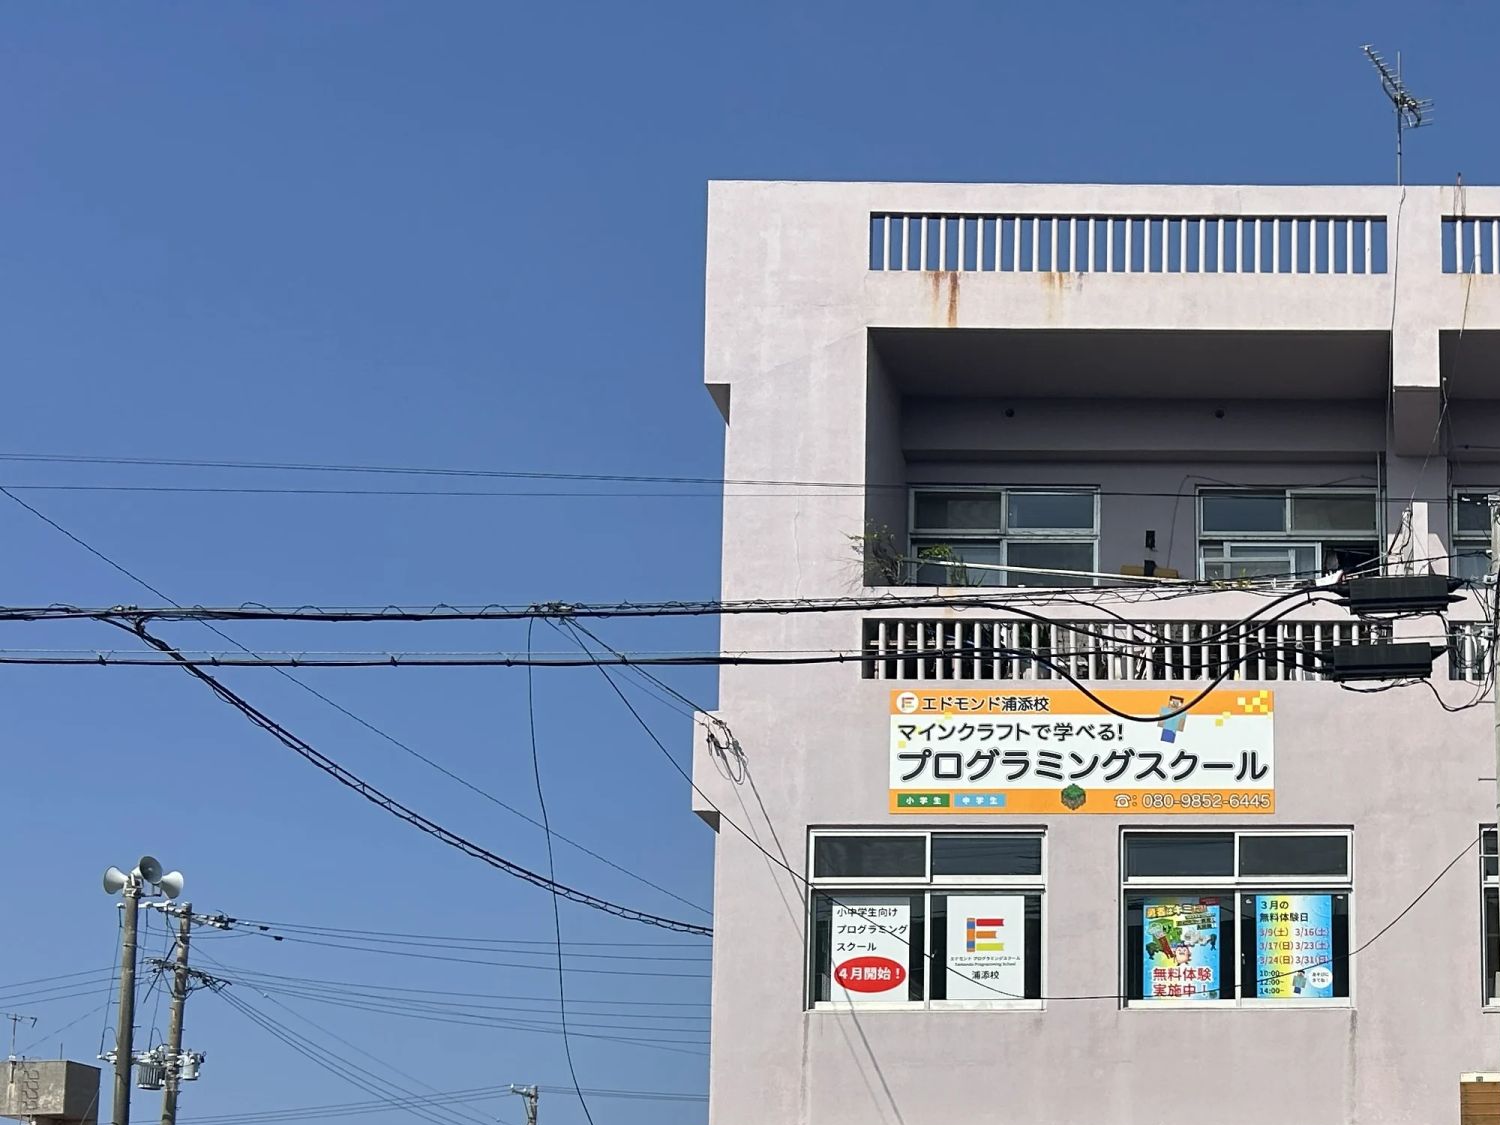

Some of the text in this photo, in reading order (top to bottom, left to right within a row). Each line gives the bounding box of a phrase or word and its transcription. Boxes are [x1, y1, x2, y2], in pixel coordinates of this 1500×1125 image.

[922, 696, 1049, 711] エドモンド浦添校
[898, 722, 1124, 742] マインクラフトで学べる!
[898, 748, 1269, 782] プログラミングスクール
[905, 796, 942, 805] 小学生
[962, 796, 998, 805] 中学生
[1261, 900, 1289, 910] 3月の
[836, 907, 898, 918] 小中学生向け
[1260, 913, 1309, 922] 無料体験日
[836, 924, 909, 935] プログラミング
[836, 942, 877, 952] スクール
[838, 966, 900, 981] 4月開始!
[971, 970, 1000, 980] 浦添校
[1153, 967, 1212, 981] 無料体験
[1153, 984, 1207, 997] 実施中!
